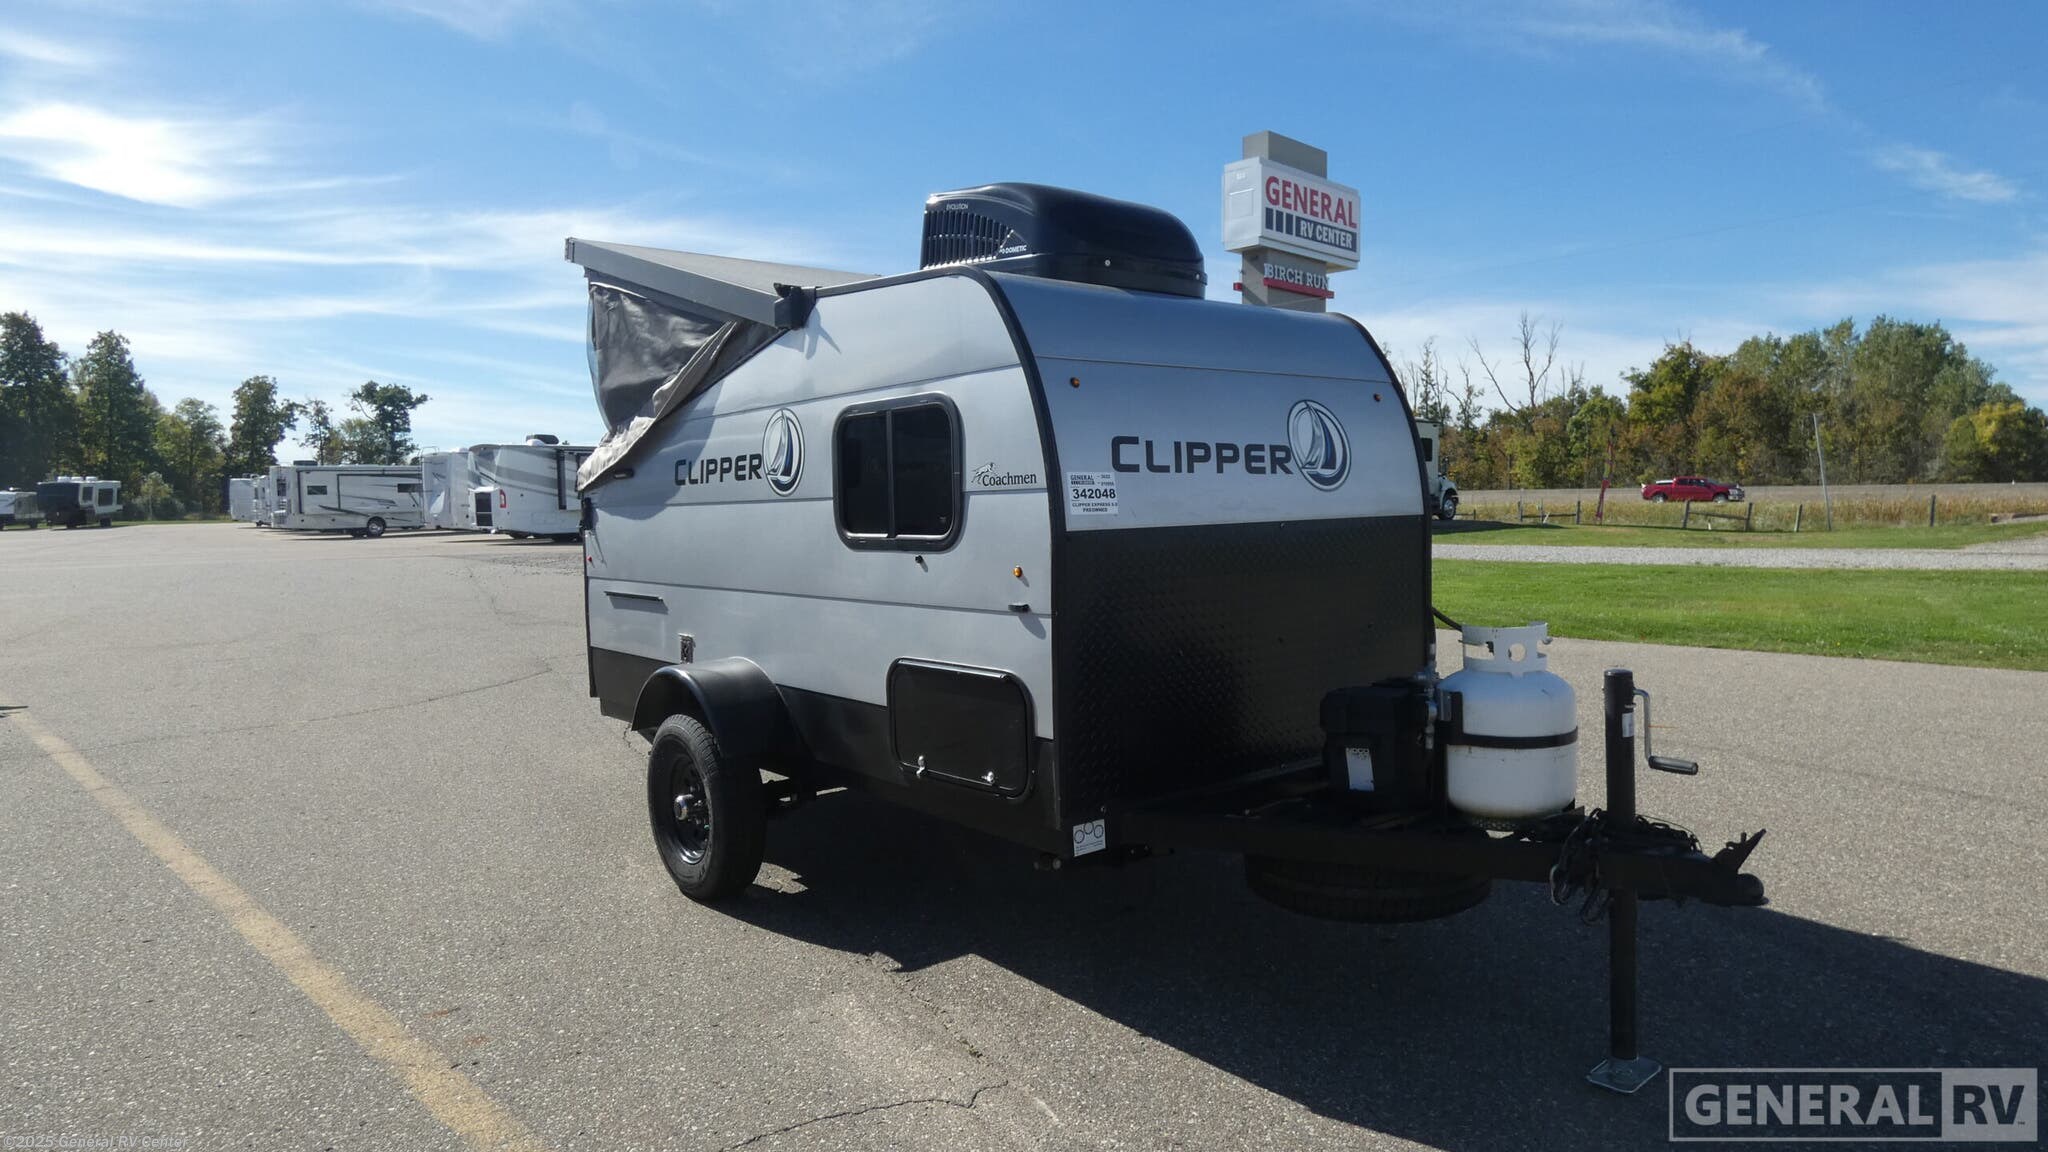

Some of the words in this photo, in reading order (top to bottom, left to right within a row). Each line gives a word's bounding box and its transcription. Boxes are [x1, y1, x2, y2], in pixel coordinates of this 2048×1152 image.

[1265, 176, 1357, 229] GENERAL
[1300, 220, 1314, 239] RV
[1315, 224, 1353, 249] CENTER
[1005, 245, 1028, 254] DOMETIC
[1264, 263, 1304, 285] BIRCH
[1305, 272, 1331, 290] RUN
[1111, 435, 1294, 475] CLIPPER
[675, 453, 762, 487] CLIPPER
[982, 471, 1037, 487] Coachmen
[1072, 488, 1116, 499] 342048
